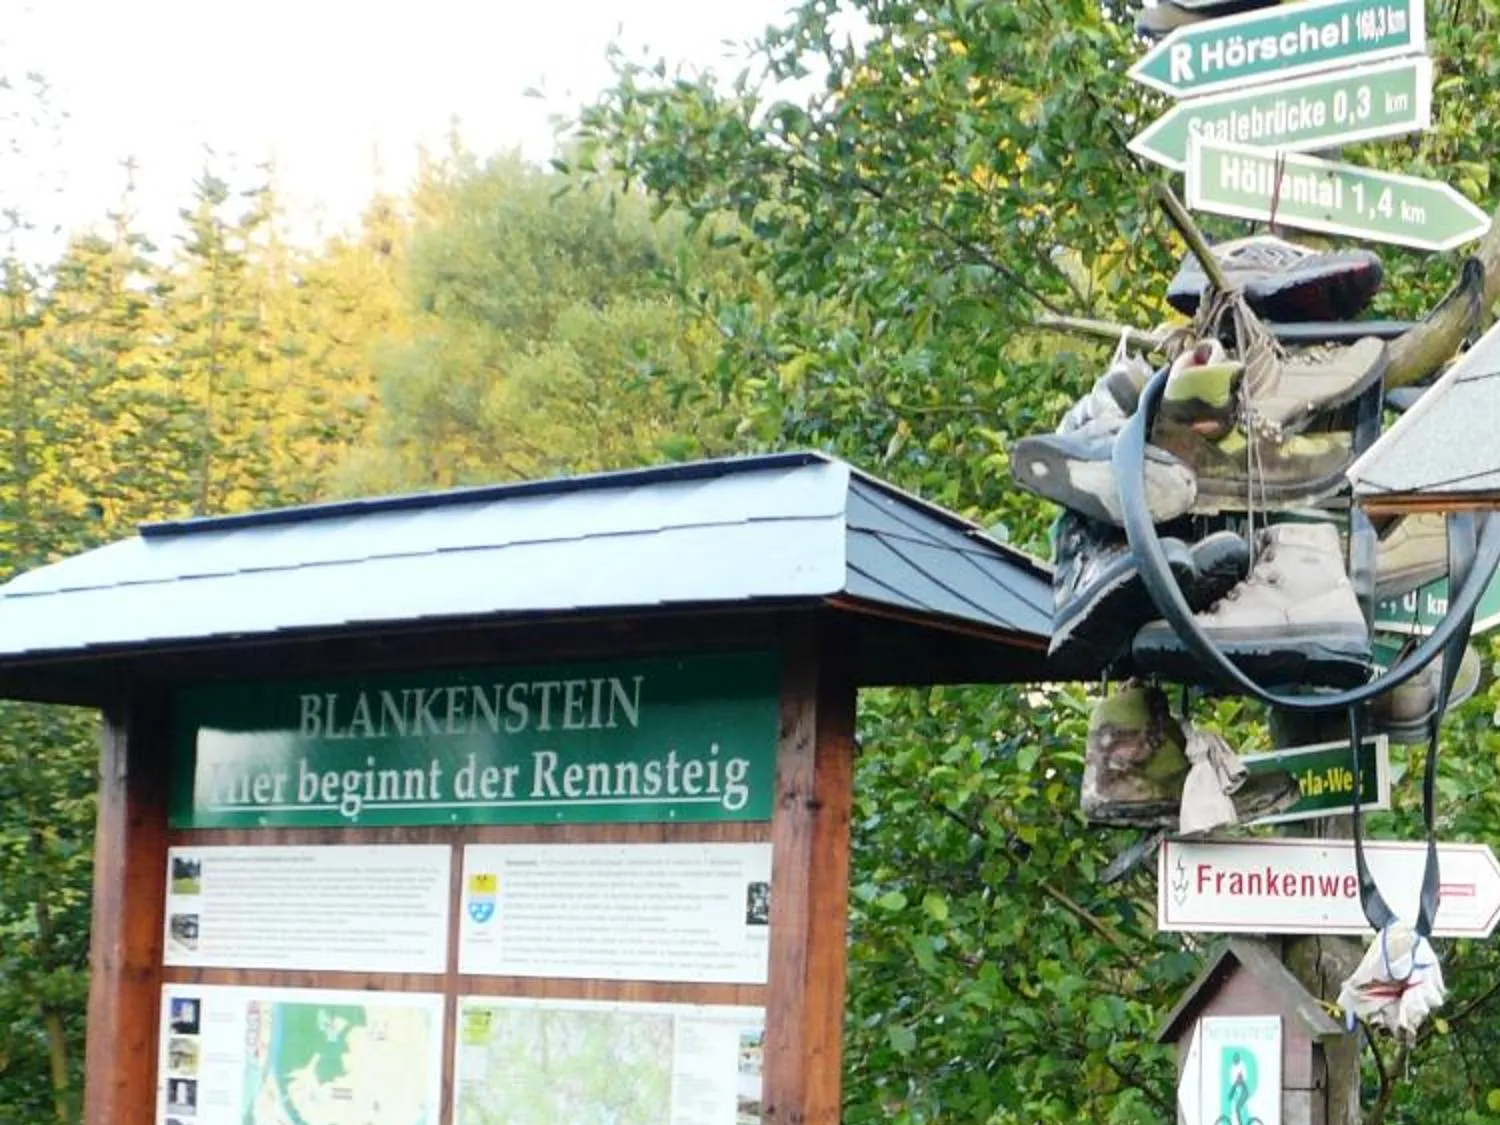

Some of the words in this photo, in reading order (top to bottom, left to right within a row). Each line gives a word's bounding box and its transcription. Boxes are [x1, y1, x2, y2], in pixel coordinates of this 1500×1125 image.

[1170, 46, 1194, 83] R
[1202, 15, 1349, 73] Hörschel
[1188, 97, 1325, 143] Saalebrücke
[1333, 87, 1371, 126] 0,3
[1385, 91, 1408, 113] km
[1220, 155, 1343, 209] Höllental
[1351, 182, 1393, 220] 1,4
[1401, 200, 1426, 225] km
[1427, 592, 1448, 616] km
[300, 675, 644, 739] BLANKENSTEIN
[299, 757, 441, 817] beginnt
[454, 760, 519, 800] der
[529, 743, 750, 810] Rennsteig
[1292, 767, 1364, 796] rla-We
[1196, 864, 1359, 898] Frankenwe
